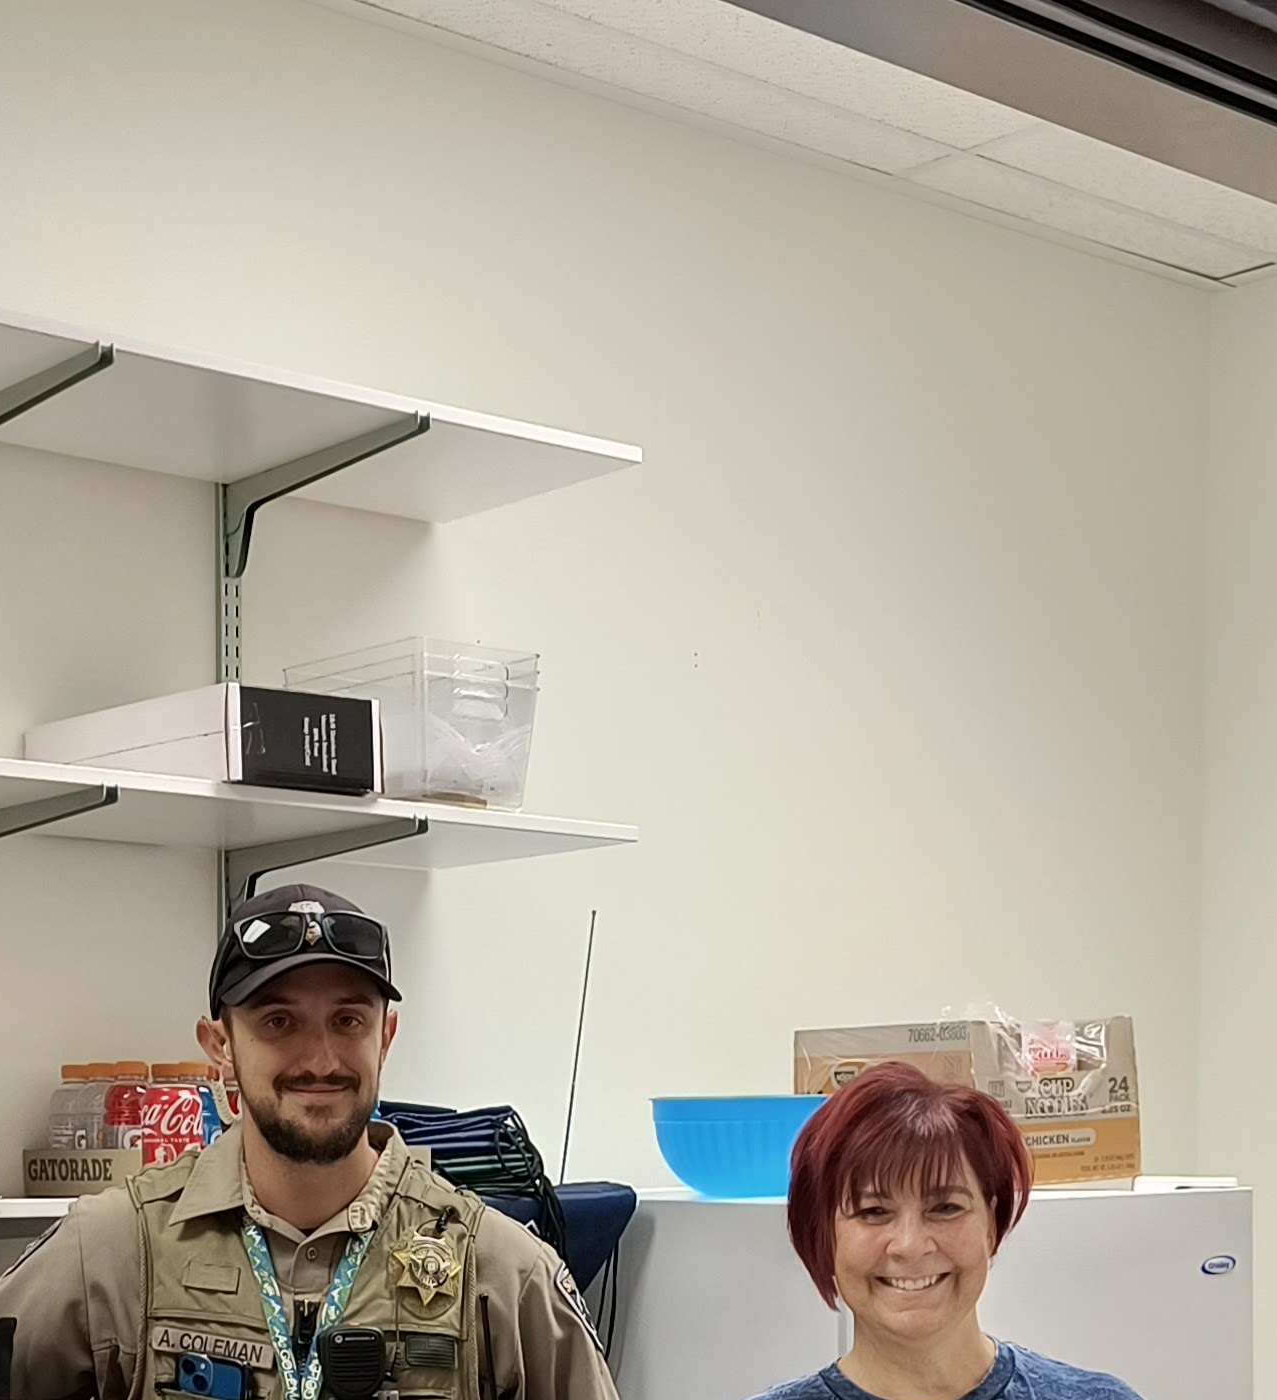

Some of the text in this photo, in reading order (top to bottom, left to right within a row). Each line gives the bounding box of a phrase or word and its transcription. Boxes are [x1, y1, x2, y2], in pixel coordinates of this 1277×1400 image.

[1038, 1077, 1075, 1098] CUP
[1108, 1076, 1130, 1093] 24
[1024, 1094, 1089, 1119] NOODLES
[1108, 1093, 1131, 1102] PACK
[1024, 1133, 1070, 1147] CHICKEN
[27, 1158, 114, 1182] GATORADE
[158, 1329, 263, 1363] A. COLEMAN
